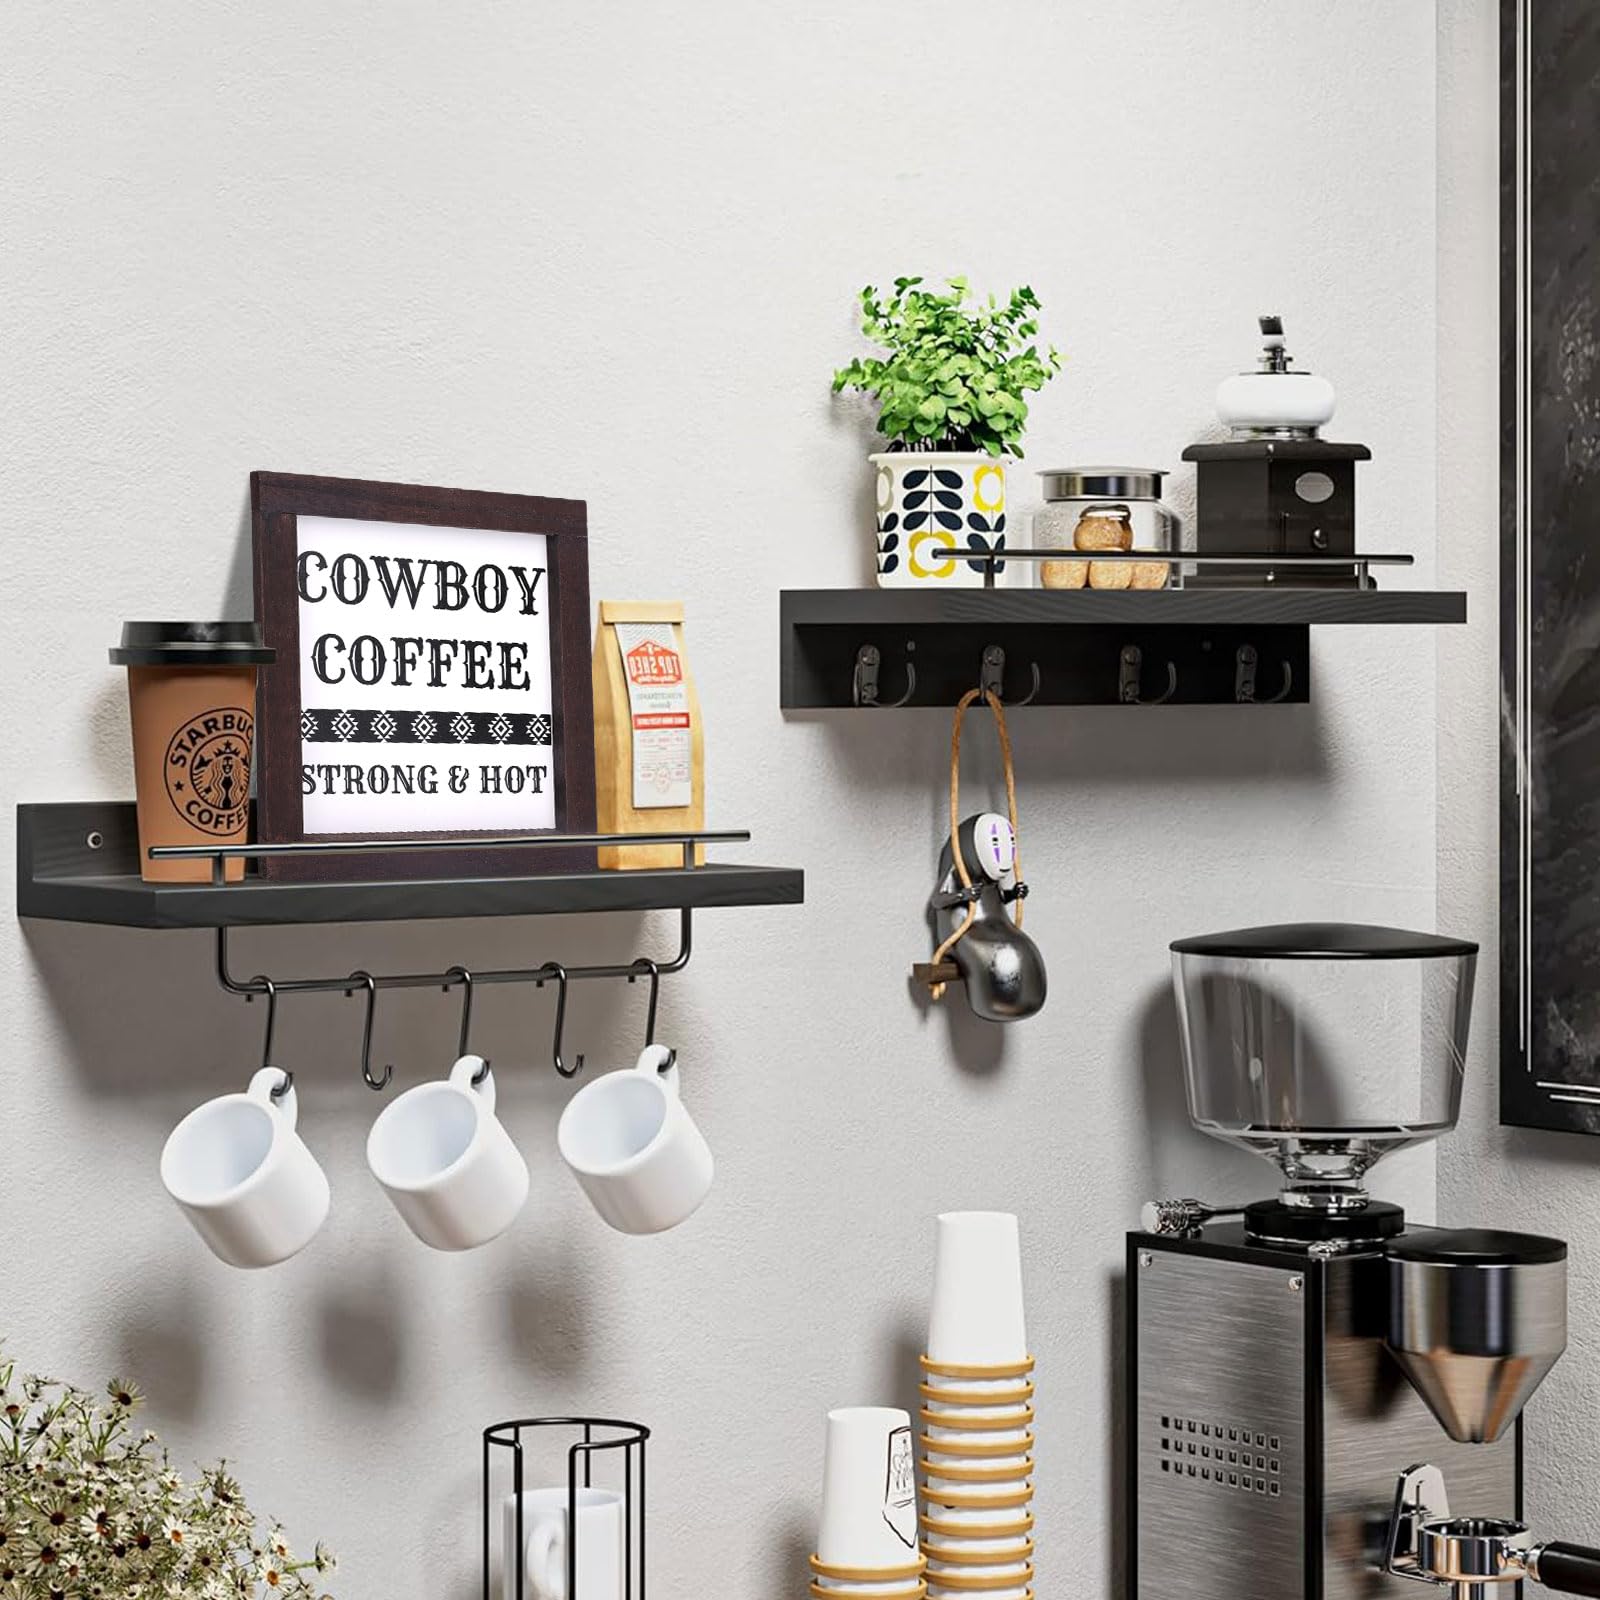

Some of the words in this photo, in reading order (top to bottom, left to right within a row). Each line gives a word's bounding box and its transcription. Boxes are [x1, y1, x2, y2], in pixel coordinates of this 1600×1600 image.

[297, 550, 546, 616] COWBOY
[311, 633, 531, 691] COFFEE
[169, 714, 254, 769] STARBUC
[302, 764, 439, 795] STRONG
[447, 766, 469, 794] &
[479, 764, 547, 795] HOT
